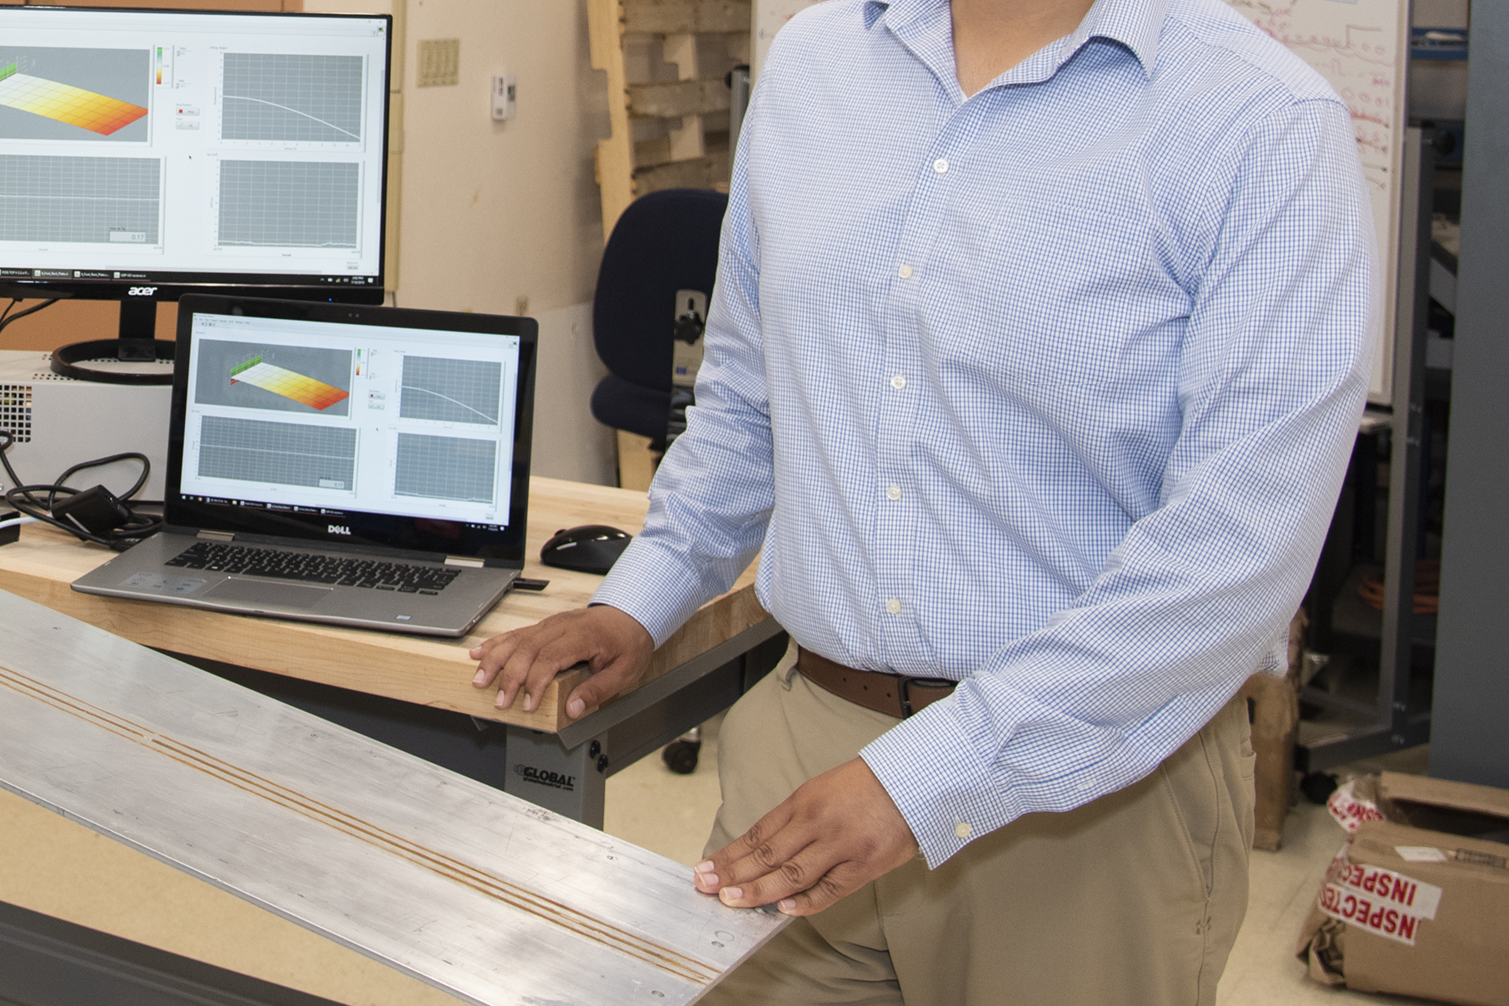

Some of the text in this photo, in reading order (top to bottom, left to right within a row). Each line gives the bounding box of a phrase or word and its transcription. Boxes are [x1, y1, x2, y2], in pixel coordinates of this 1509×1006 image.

[128, 286, 157, 297] acer
[328, 524, 352, 535] DELL
[523, 767, 574, 787] GLOBAL
